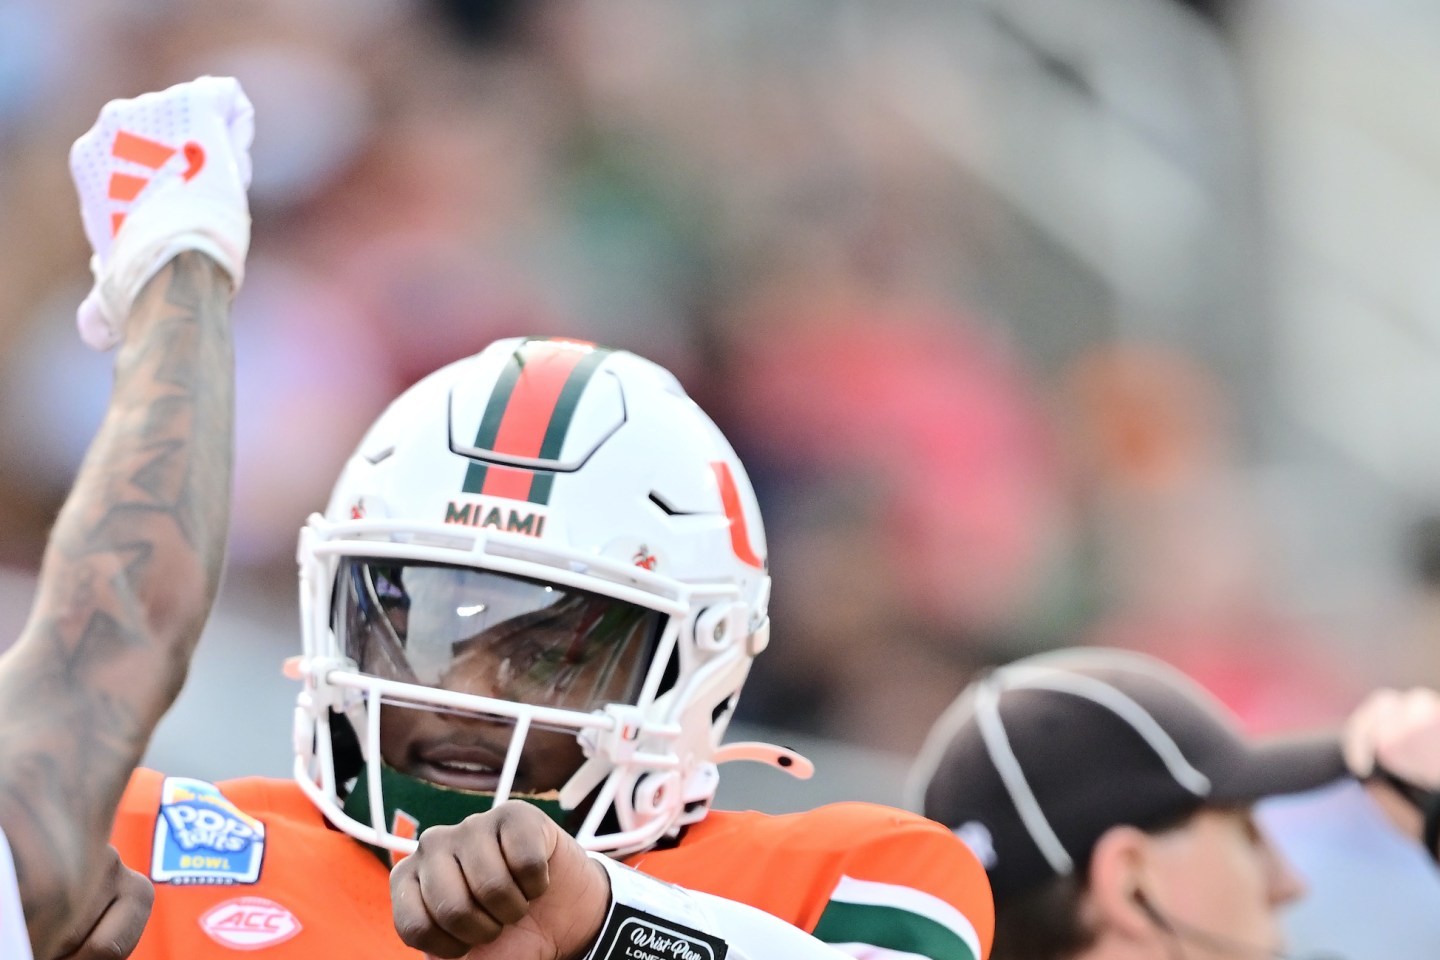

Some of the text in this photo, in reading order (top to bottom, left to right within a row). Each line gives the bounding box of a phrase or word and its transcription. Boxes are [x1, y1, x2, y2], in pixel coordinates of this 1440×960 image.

[445, 501, 546, 538] MIAMI
[179, 855, 230, 870] BOWL
[216, 911, 285, 930] ACC
[630, 926, 671, 953] Wrist
